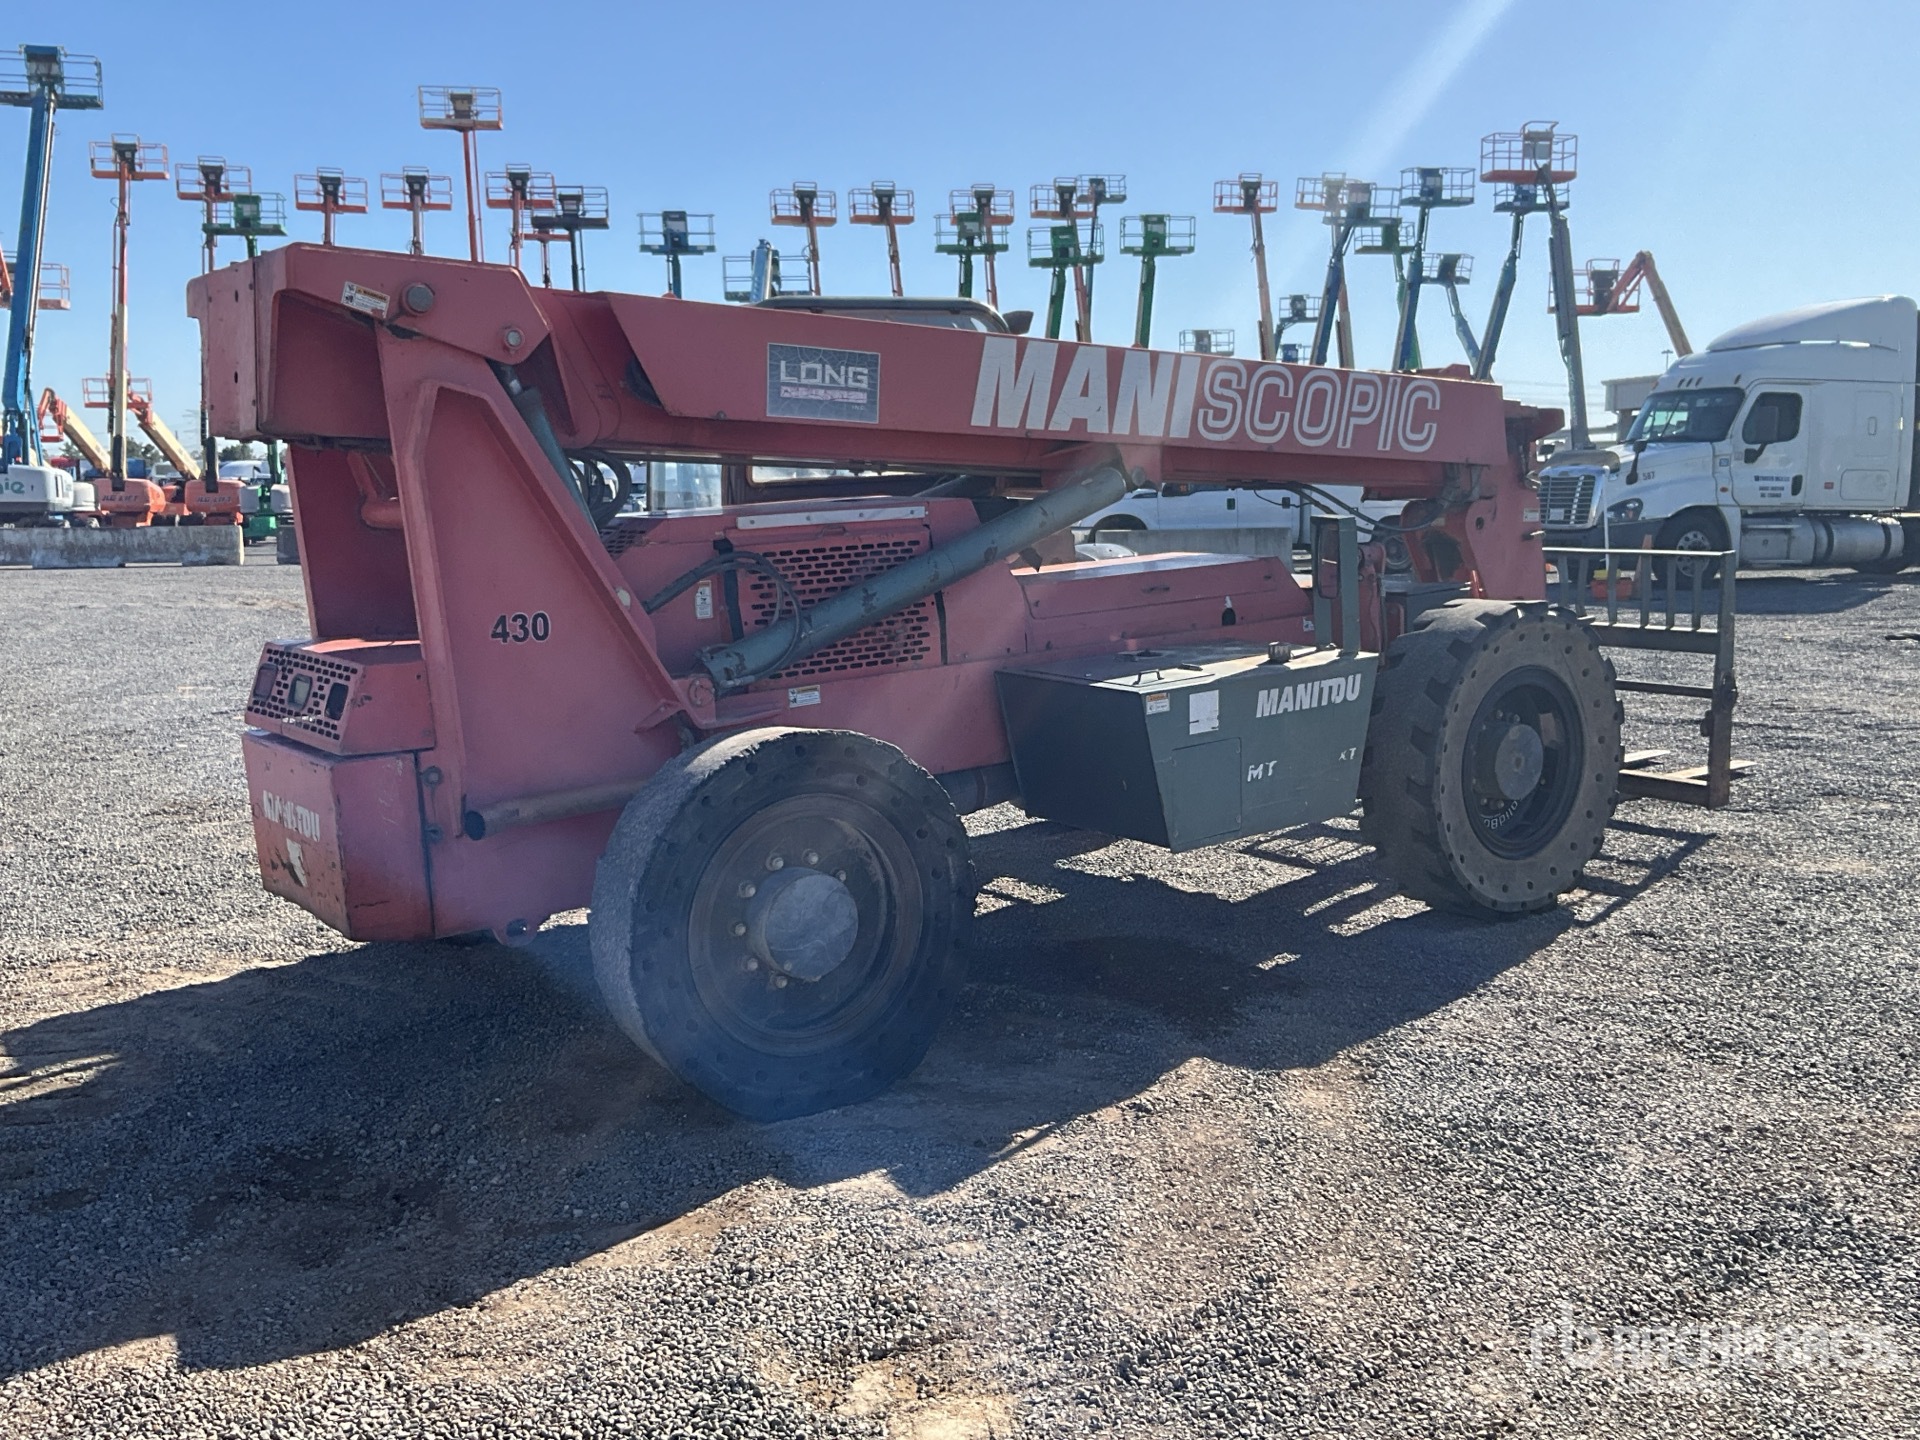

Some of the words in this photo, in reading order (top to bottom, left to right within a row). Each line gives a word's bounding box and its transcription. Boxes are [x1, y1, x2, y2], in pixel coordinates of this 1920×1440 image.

[780, 360, 869, 389] LONG
[971, 335, 1441, 453] MANISCOPIC
[490, 611, 551, 644] 430
[1255, 673, 1362, 718] MANITOU
